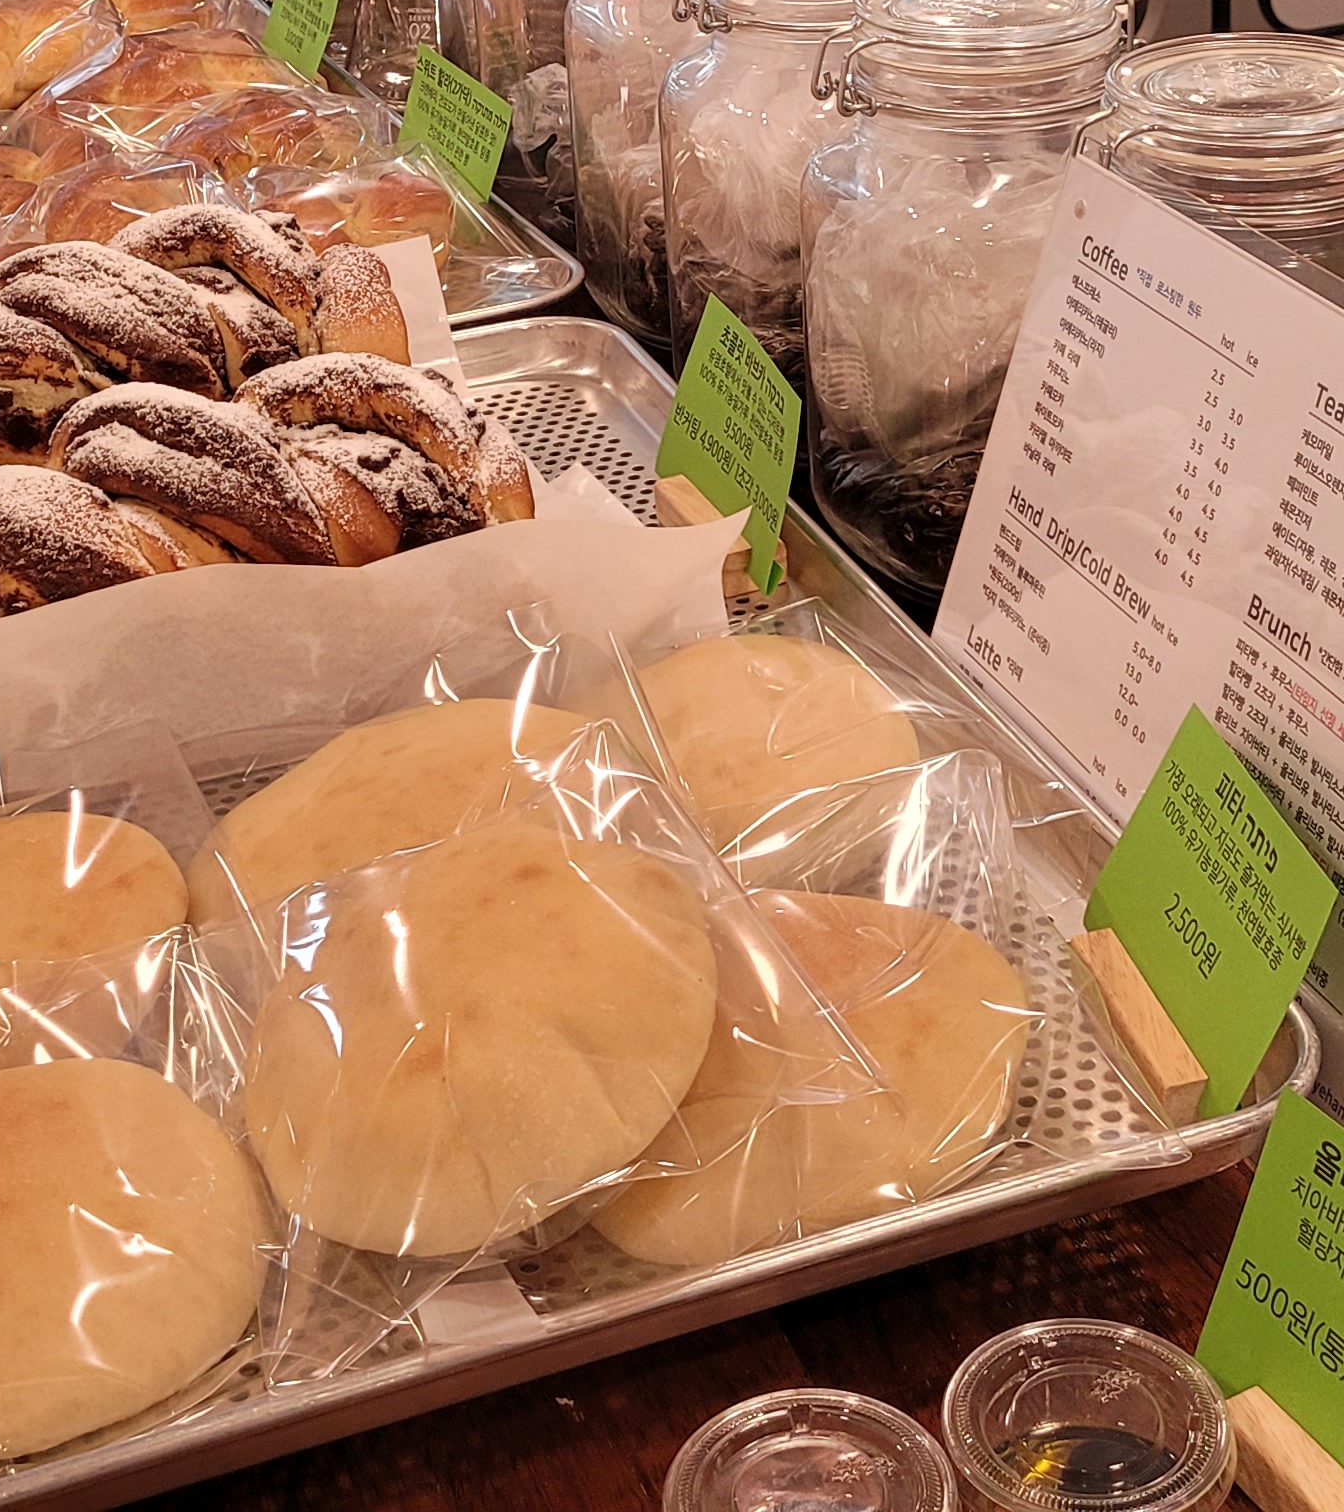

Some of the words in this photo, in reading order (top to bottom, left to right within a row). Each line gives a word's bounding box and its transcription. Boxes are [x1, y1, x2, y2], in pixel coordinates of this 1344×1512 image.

[1081, 235, 1128, 281] Coffee
[1155, 280, 1183, 308] 로스팅한
[1186, 300, 1202, 319] 원두
[1220, 333, 1234, 352] hot
[1245, 350, 1258, 368] ice
[699, 363, 717, 388] 100%
[1210, 368, 1225, 385] 2.5
[1204, 390, 1218, 408] 2.5
[1228, 407, 1243, 425] 3.0
[723, 415, 753, 461] 9,500원
[1196, 414, 1211, 432] 3.0
[1221, 432, 1235, 450] 3.5
[673, 402, 701, 440] 반커팅
[734, 462, 754, 498] 1조각
[748, 484, 779, 533] 3,000원
[1189, 438, 1203, 455] 3.5
[1214, 457, 1228, 474] 4.0
[1183, 460, 1197, 478] 3.5
[1207, 479, 1221, 496] 4.0
[1175, 483, 1189, 500] 4.0
[1201, 503, 1215, 520] 4.5
[1279, 497, 1312, 531] 레몬진저
[1168, 505, 1182, 522] 4.0
[1194, 526, 1208, 543] 4.5
[1162, 527, 1176, 544] 4.0
[1186, 547, 1201, 565] 4.5
[1008, 485, 1044, 528] Hand
[1045, 516, 1112, 593] Drip/Cold
[1112, 573, 1151, 619] Brew
[1150, 614, 1164, 634] hot
[1166, 627, 1178, 646] ice
[1154, 548, 1168, 565] 4.0
[1180, 570, 1194, 587] 4.5
[1319, 555, 1336, 581] 레몬,
[1320, 585, 1344, 617] 레몬차,
[1247, 593, 1311, 661] Brunch
[1125, 662, 1142, 683] 13.0
[1132, 640, 1161, 673] 5.0~8.0
[966, 624, 1001, 671] Latte
[1092, 755, 1105, 776] hot
[1115, 777, 1126, 797] ice
[1114, 708, 1128, 727] 0.0
[1131, 724, 1145, 743] 0.0
[1285, 707, 1308, 736] 후무스
[1214, 771, 1245, 825] 피타
[1164, 759, 1185, 792] 가장
[1180, 783, 1217, 837] 오래되고
[1213, 825, 1244, 872] 지금도
[1239, 861, 1276, 922] 즐겨먹는
[1276, 911, 1306, 960] 식사빵
[1161, 795, 1188, 836] 100%
[1184, 828, 1238, 910] 유기농밀가루,
[1235, 898, 1284, 970] 천연발효종
[1163, 892, 1221, 979] 2,500원
